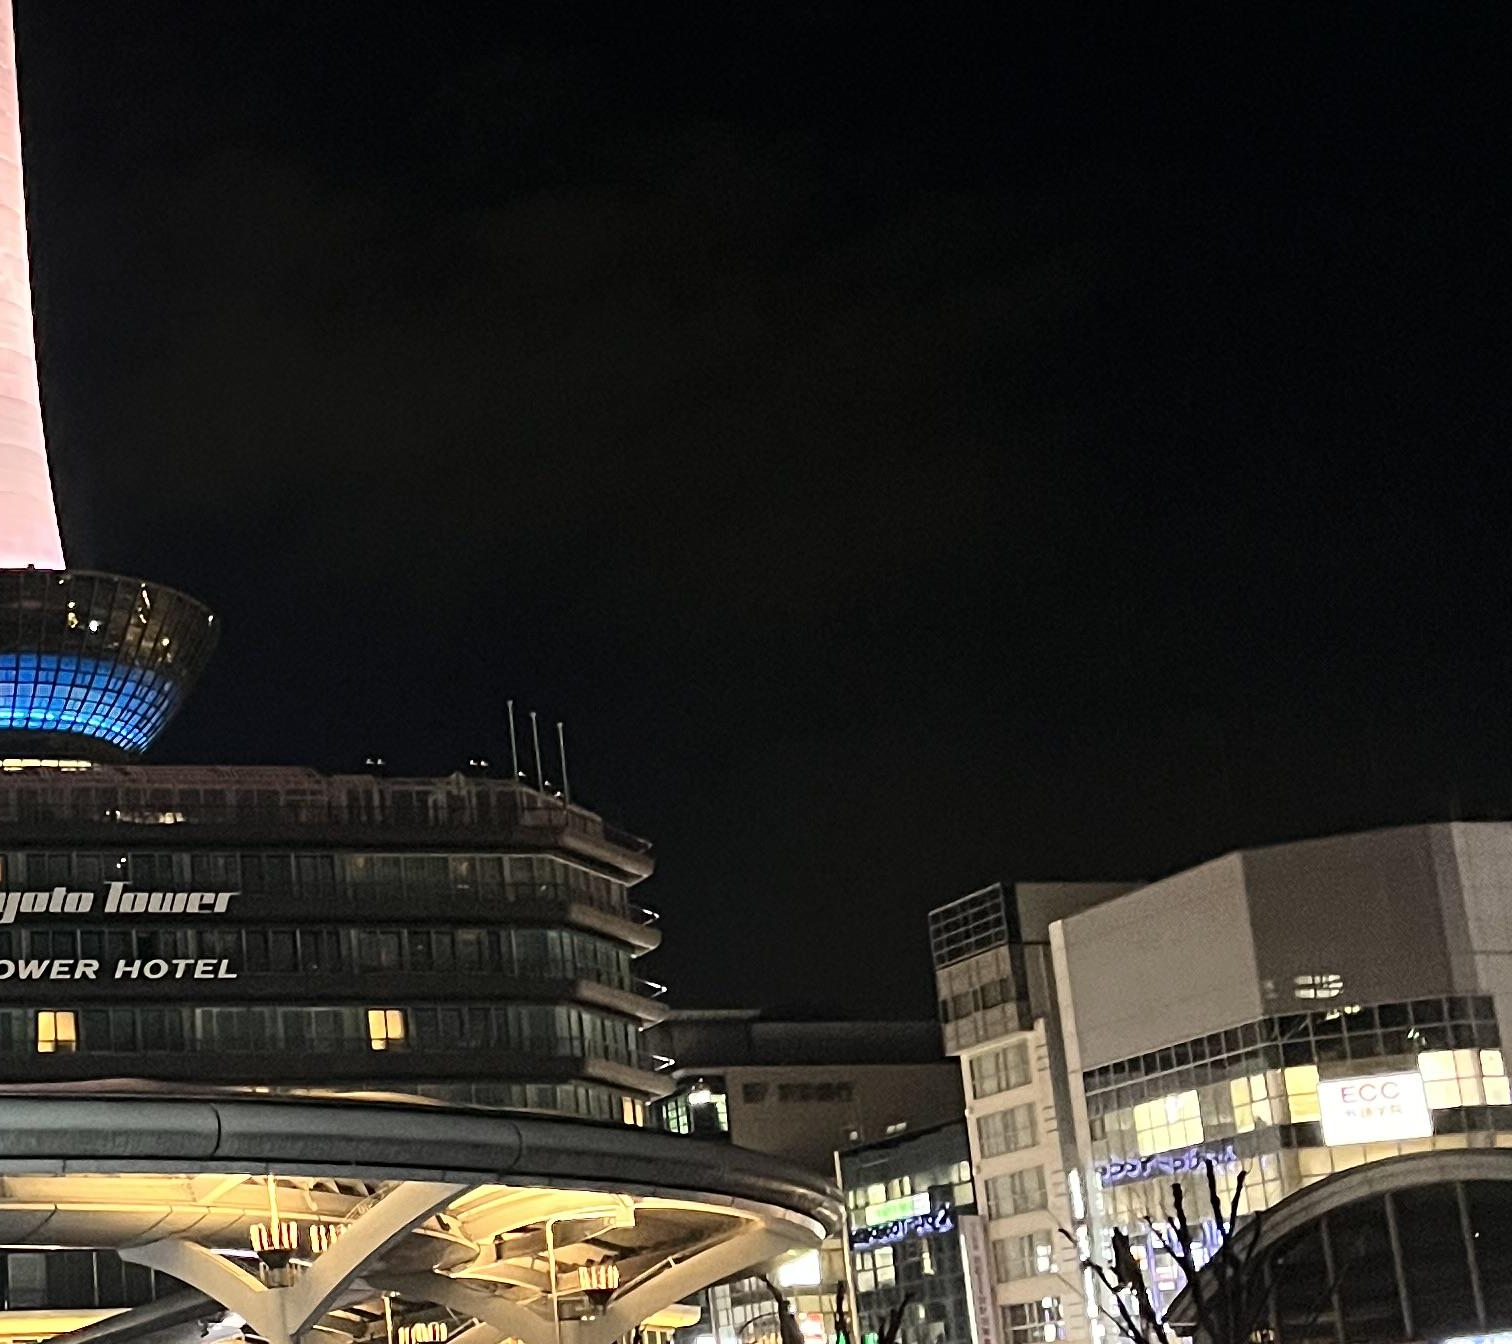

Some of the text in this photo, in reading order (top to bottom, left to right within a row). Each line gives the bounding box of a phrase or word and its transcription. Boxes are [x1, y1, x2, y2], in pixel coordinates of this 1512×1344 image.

[104, 881, 242, 913] Tower
[114, 959, 238, 980] HOTEL
[1341, 1082, 1400, 1104] ECC
